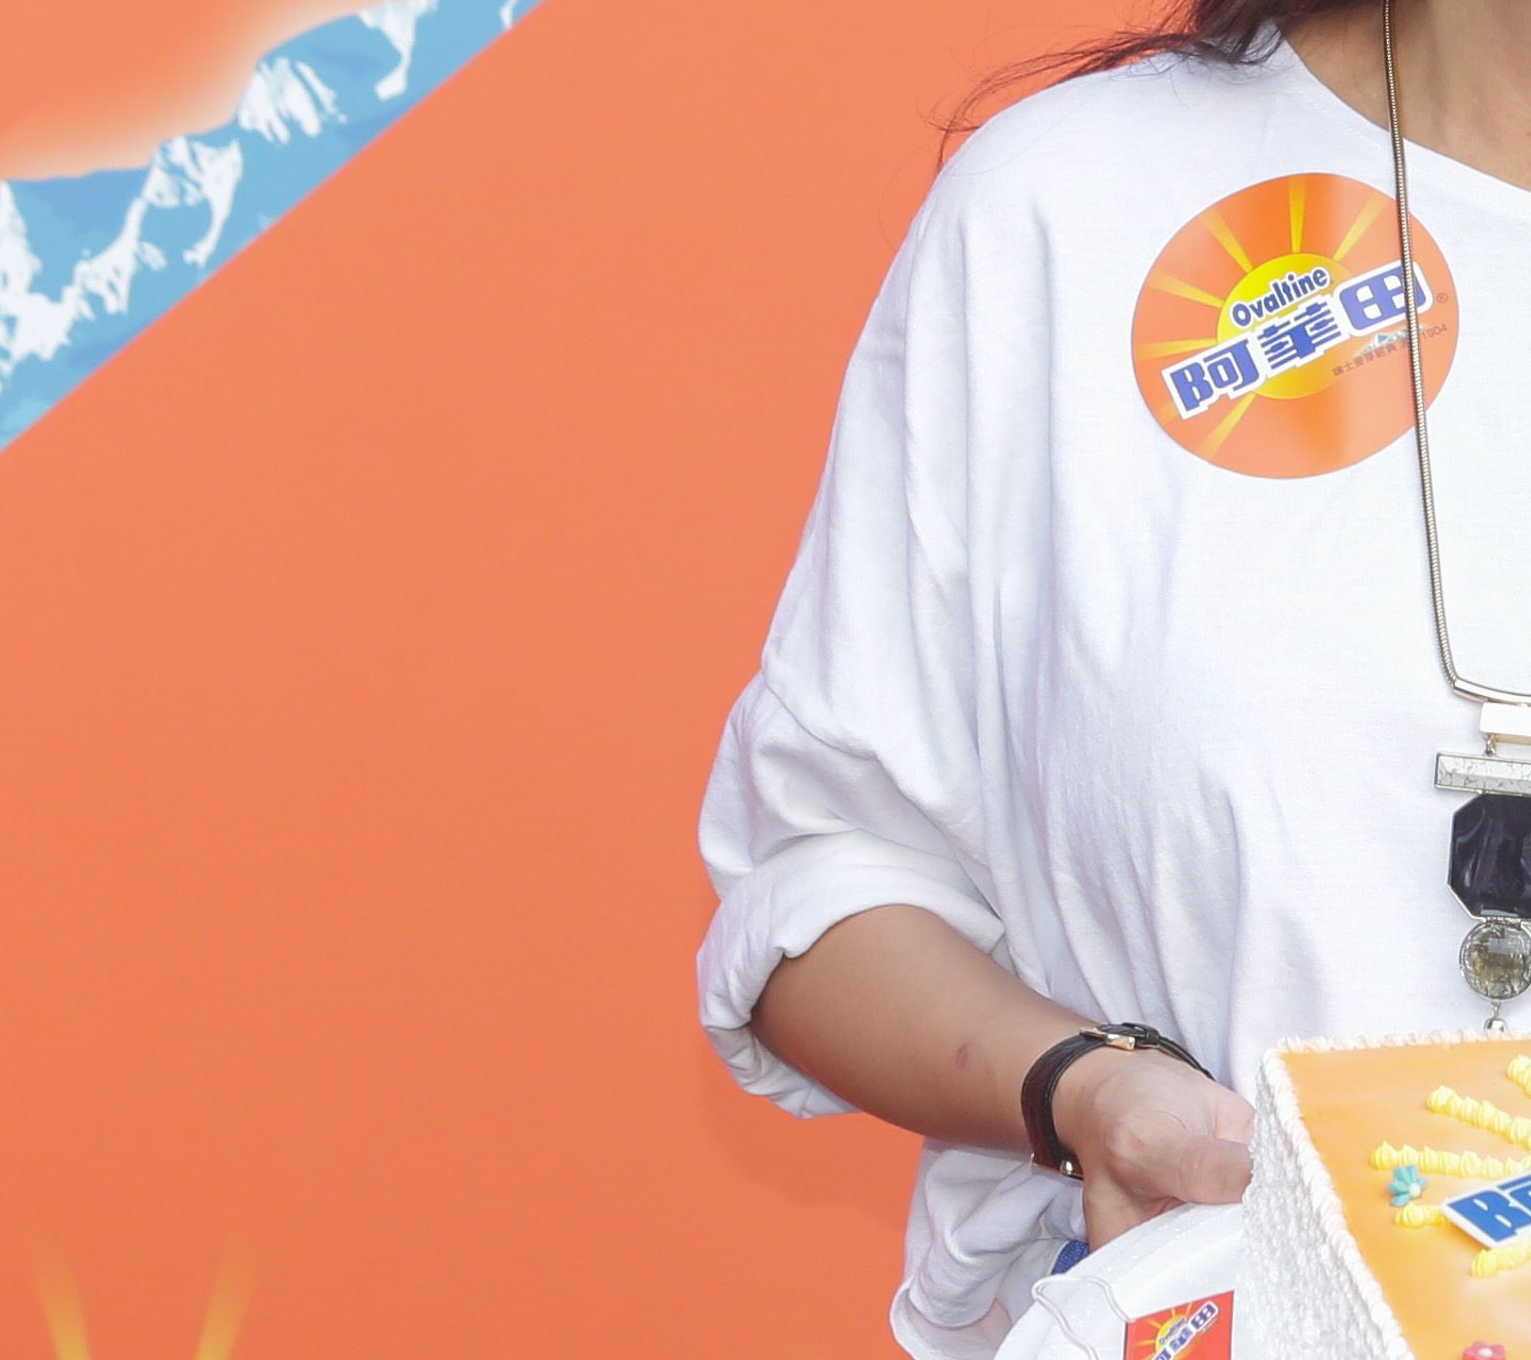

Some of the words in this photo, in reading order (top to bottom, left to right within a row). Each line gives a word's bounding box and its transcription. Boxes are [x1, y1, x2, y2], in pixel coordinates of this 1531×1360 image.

[1170, 262, 1426, 411] 阿華田
[1232, 267, 1329, 326] Ovaltine
